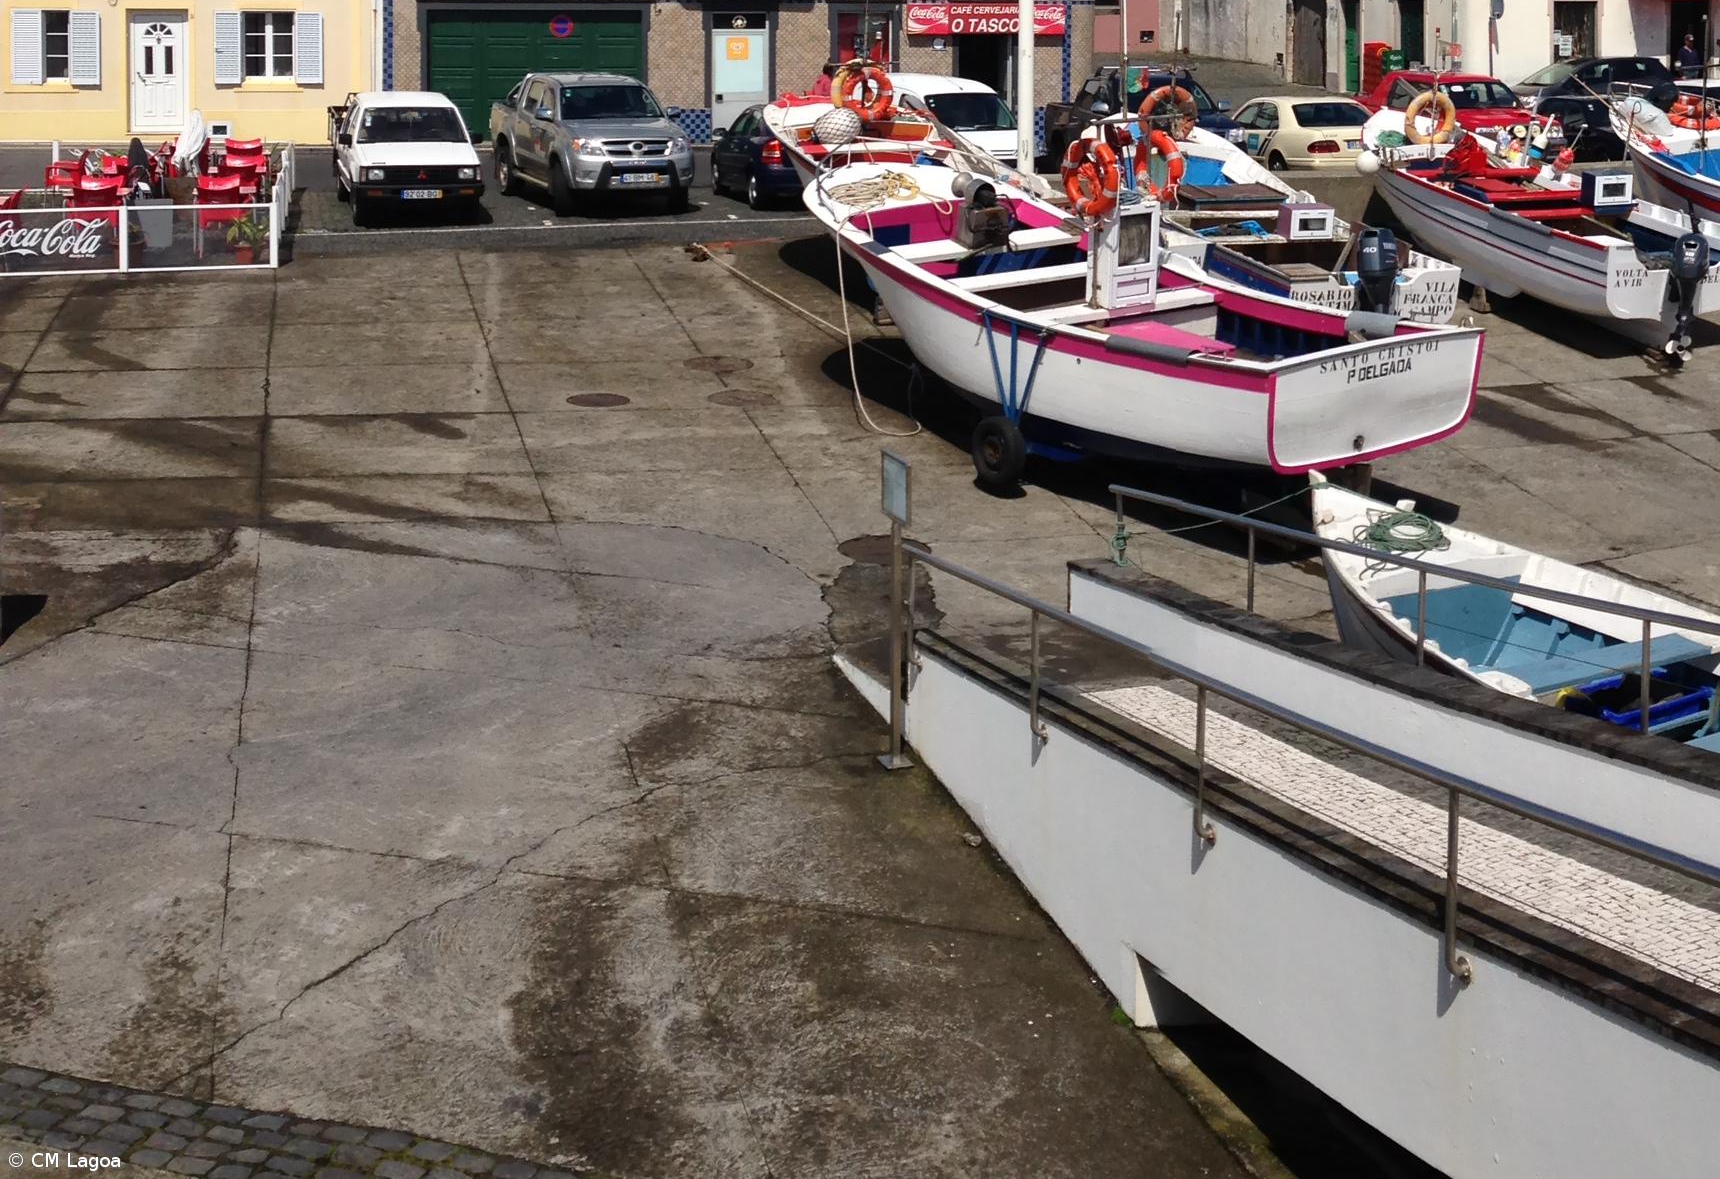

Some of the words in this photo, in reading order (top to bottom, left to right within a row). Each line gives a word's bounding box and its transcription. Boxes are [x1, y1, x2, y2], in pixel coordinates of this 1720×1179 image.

[951, 5, 972, 14] CAFÉ
[974, 6, 1019, 14] CERVEJARI
[952, 18, 963, 32] O
[969, 18, 1019, 32] TASCO
[1616, 269, 1648, 278] VOLTA
[1426, 282, 1456, 293] VILA
[1292, 290, 1350, 301] ROSARIO
[1404, 294, 1453, 304] FRANCA
[1320, 353, 1369, 374] SANTO
[1347, 369, 1355, 383] P
[1358, 357, 1412, 382] DELGADA
